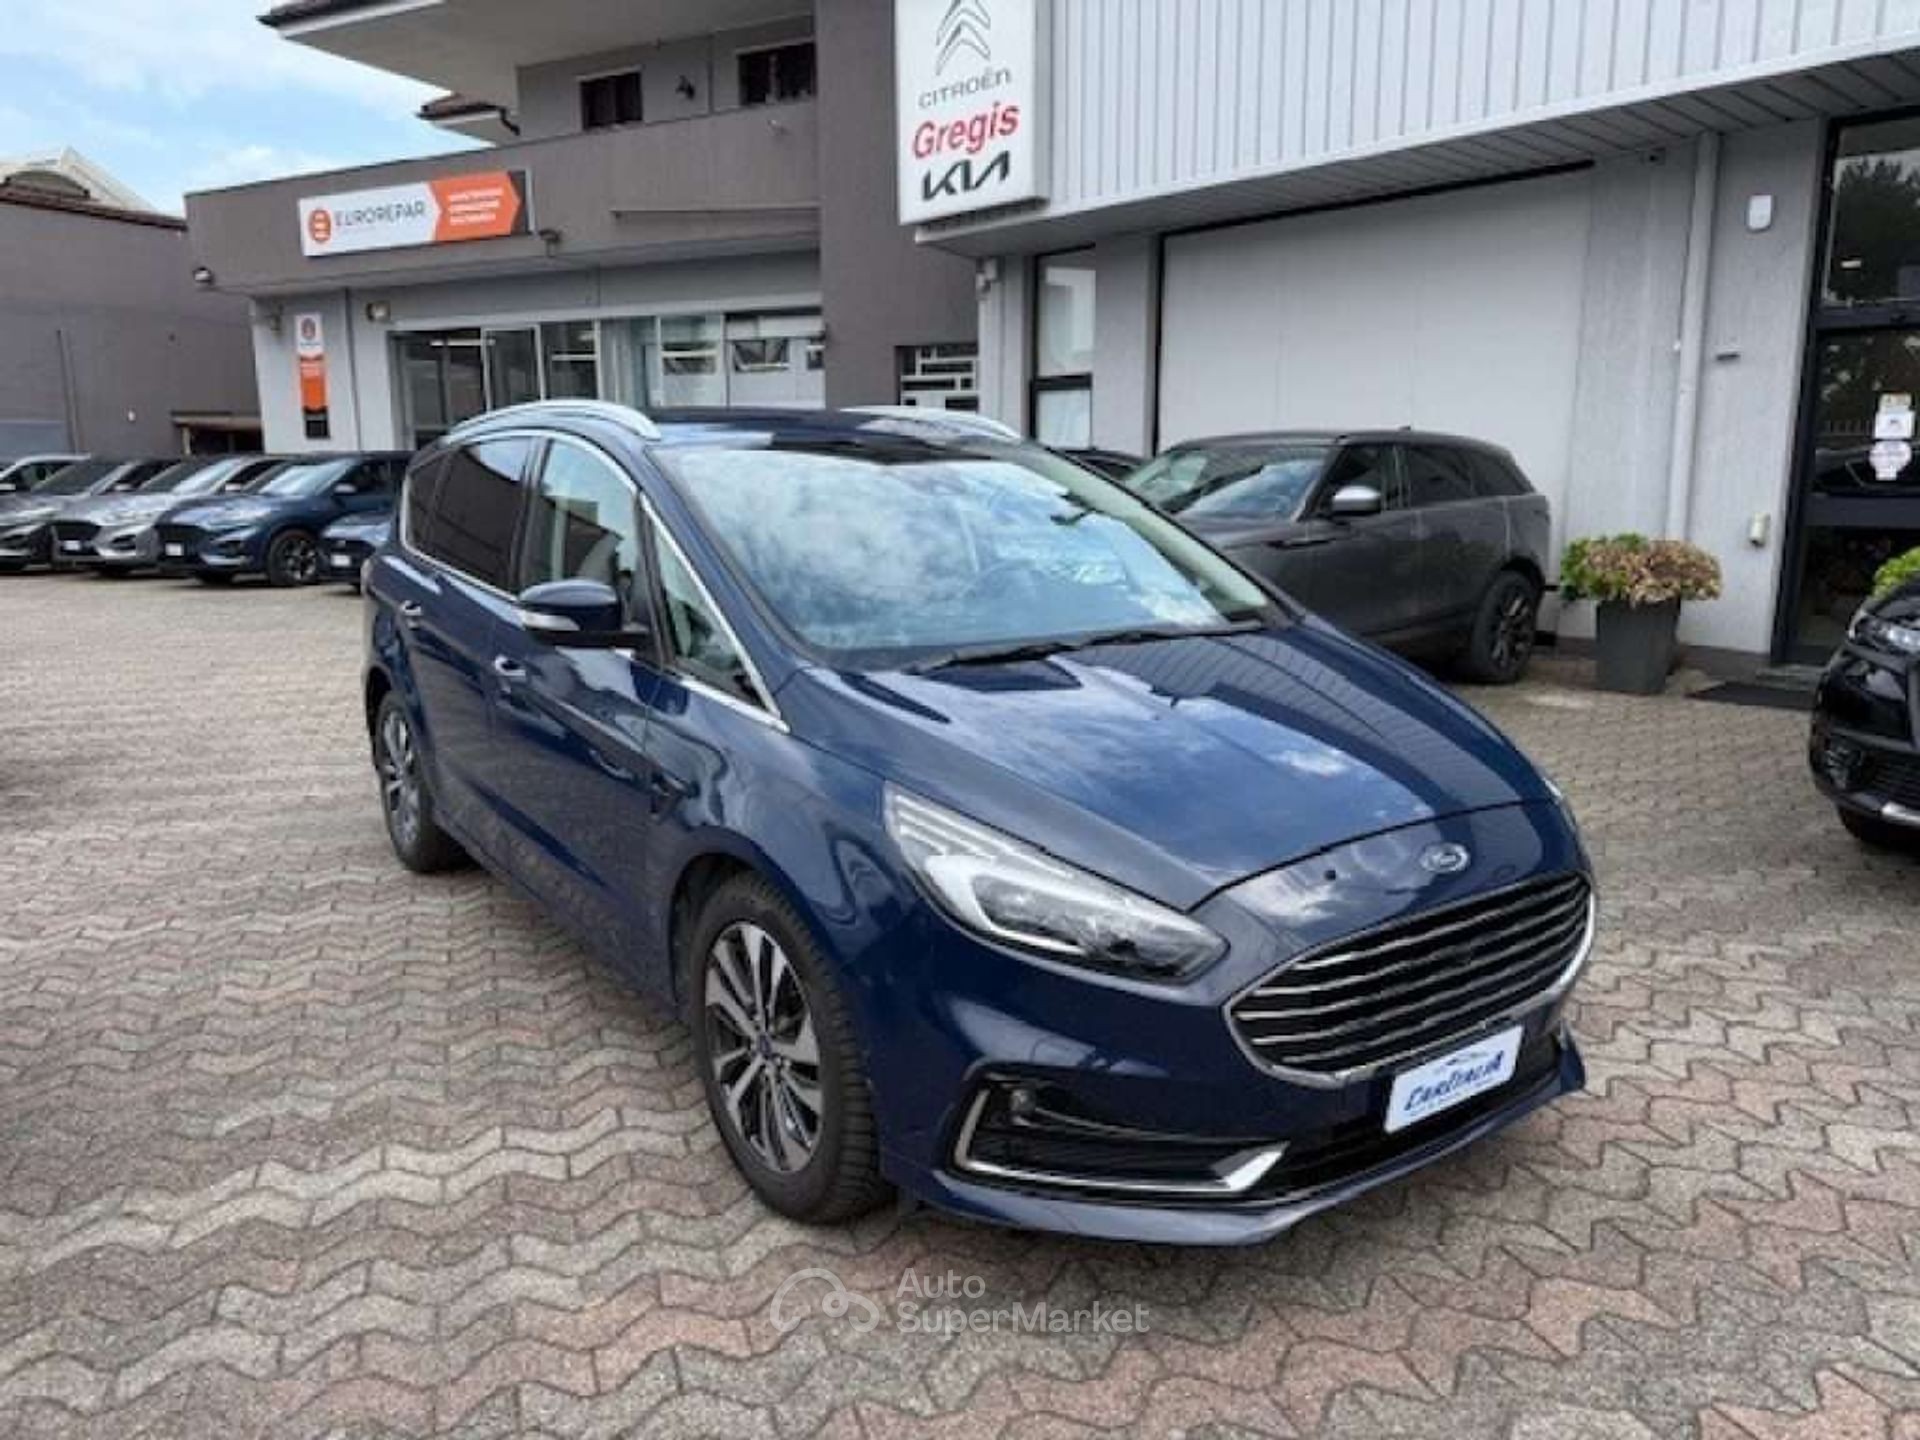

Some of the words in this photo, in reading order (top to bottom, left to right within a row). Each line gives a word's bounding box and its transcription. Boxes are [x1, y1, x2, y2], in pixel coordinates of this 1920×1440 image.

[917, 66, 1012, 109] CITROËN
[913, 101, 1020, 160] Gregis
[922, 150, 1010, 202] KIA
